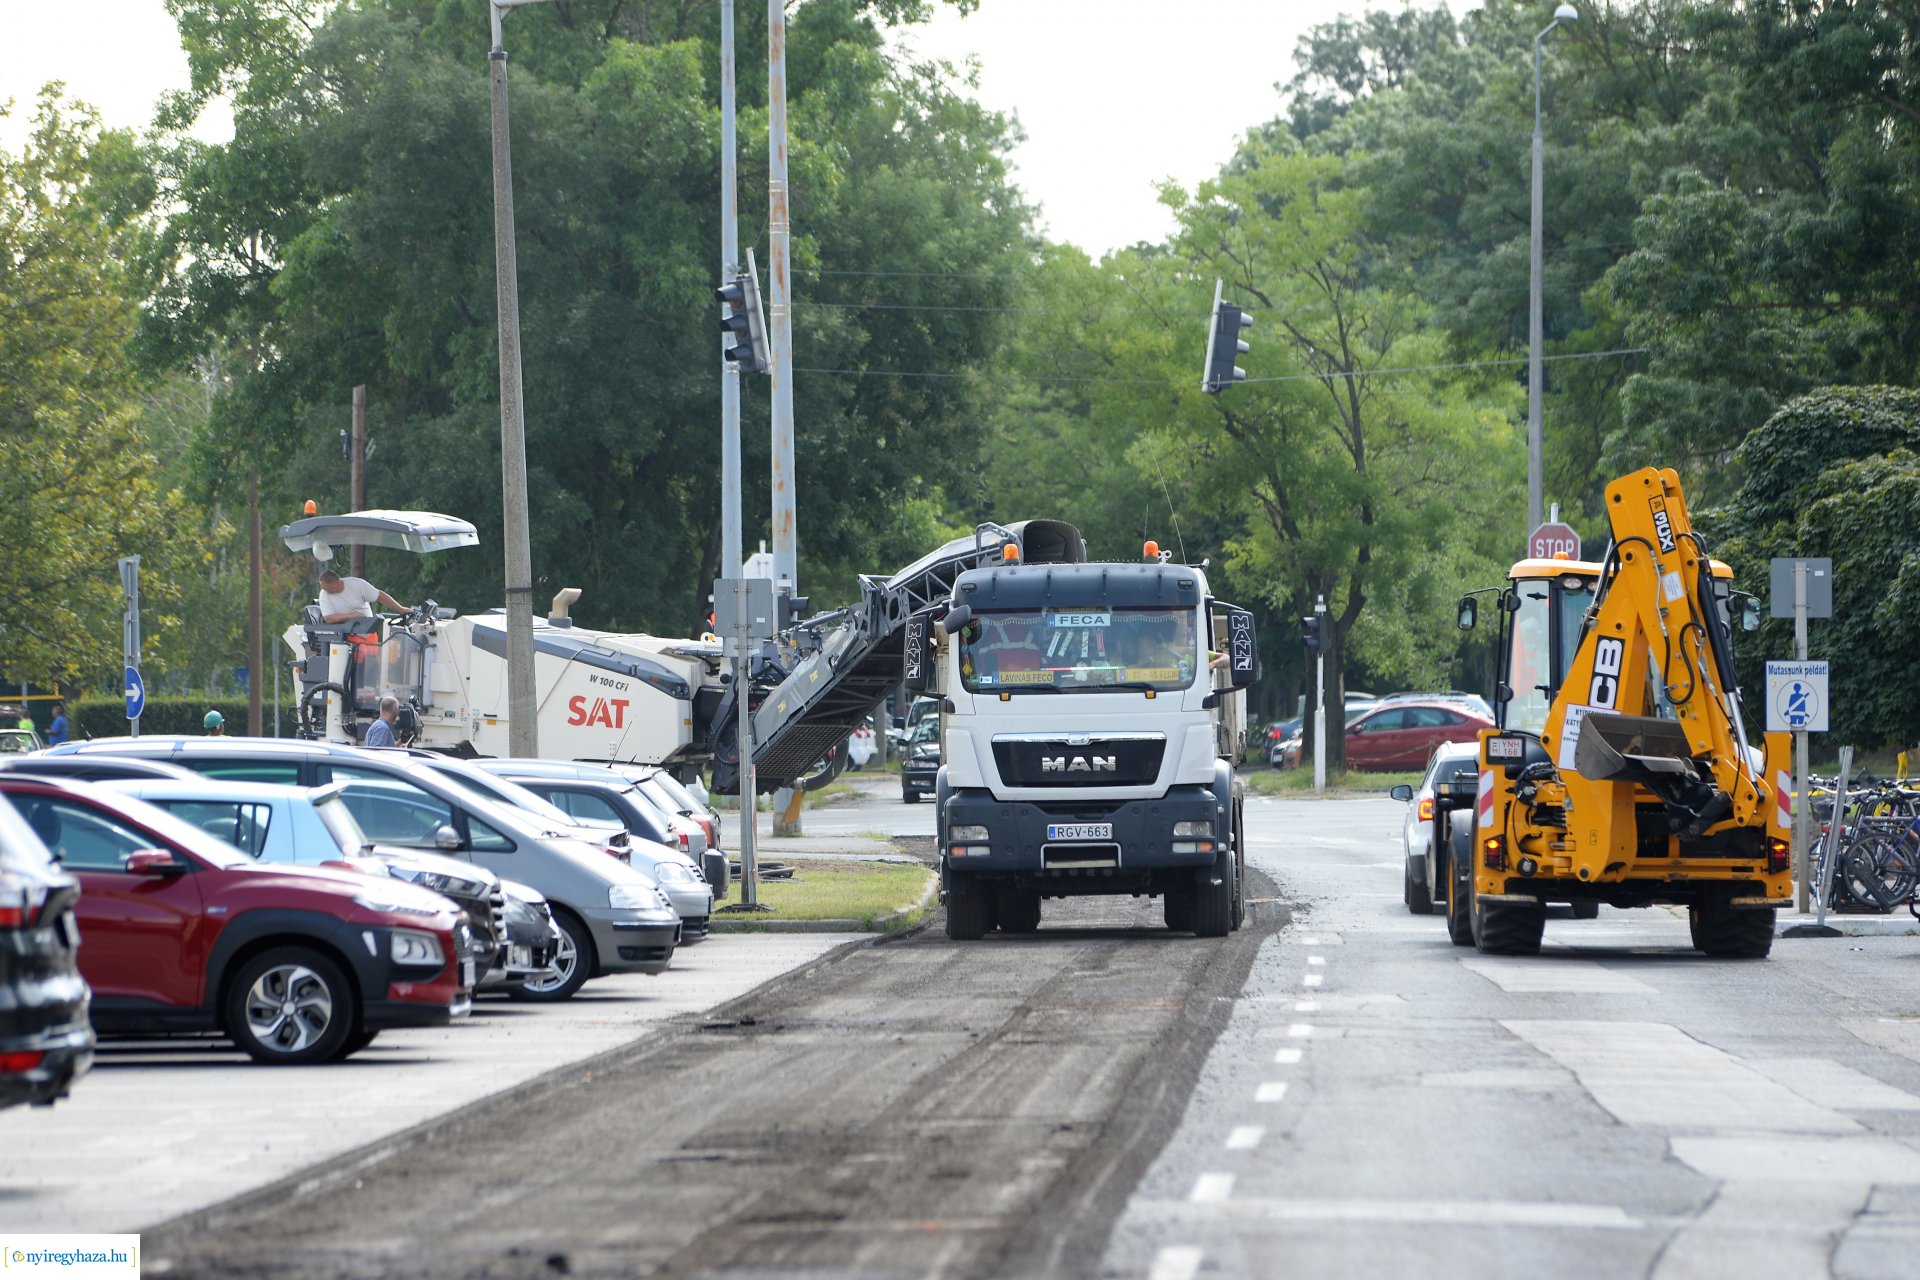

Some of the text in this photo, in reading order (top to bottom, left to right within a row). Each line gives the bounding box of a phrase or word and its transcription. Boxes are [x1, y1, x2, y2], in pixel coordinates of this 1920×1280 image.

[1653, 511, 1676, 549] 3CX
[1535, 538, 1575, 558] STOP
[1060, 616, 1105, 625] FECA
[906, 623, 923, 666] MAN
[1231, 615, 1252, 657] MAN
[1589, 639, 1623, 709] CB
[1768, 664, 1827, 678] Mutassunk példát!
[589, 674, 599, 684] W
[600, 677, 614, 688] 100
[567, 695, 630, 729] SAT
[1502, 740, 1520, 748] YNH
[1041, 756, 1116, 772] MAN
[1057, 826, 1109, 838] RGV-663
